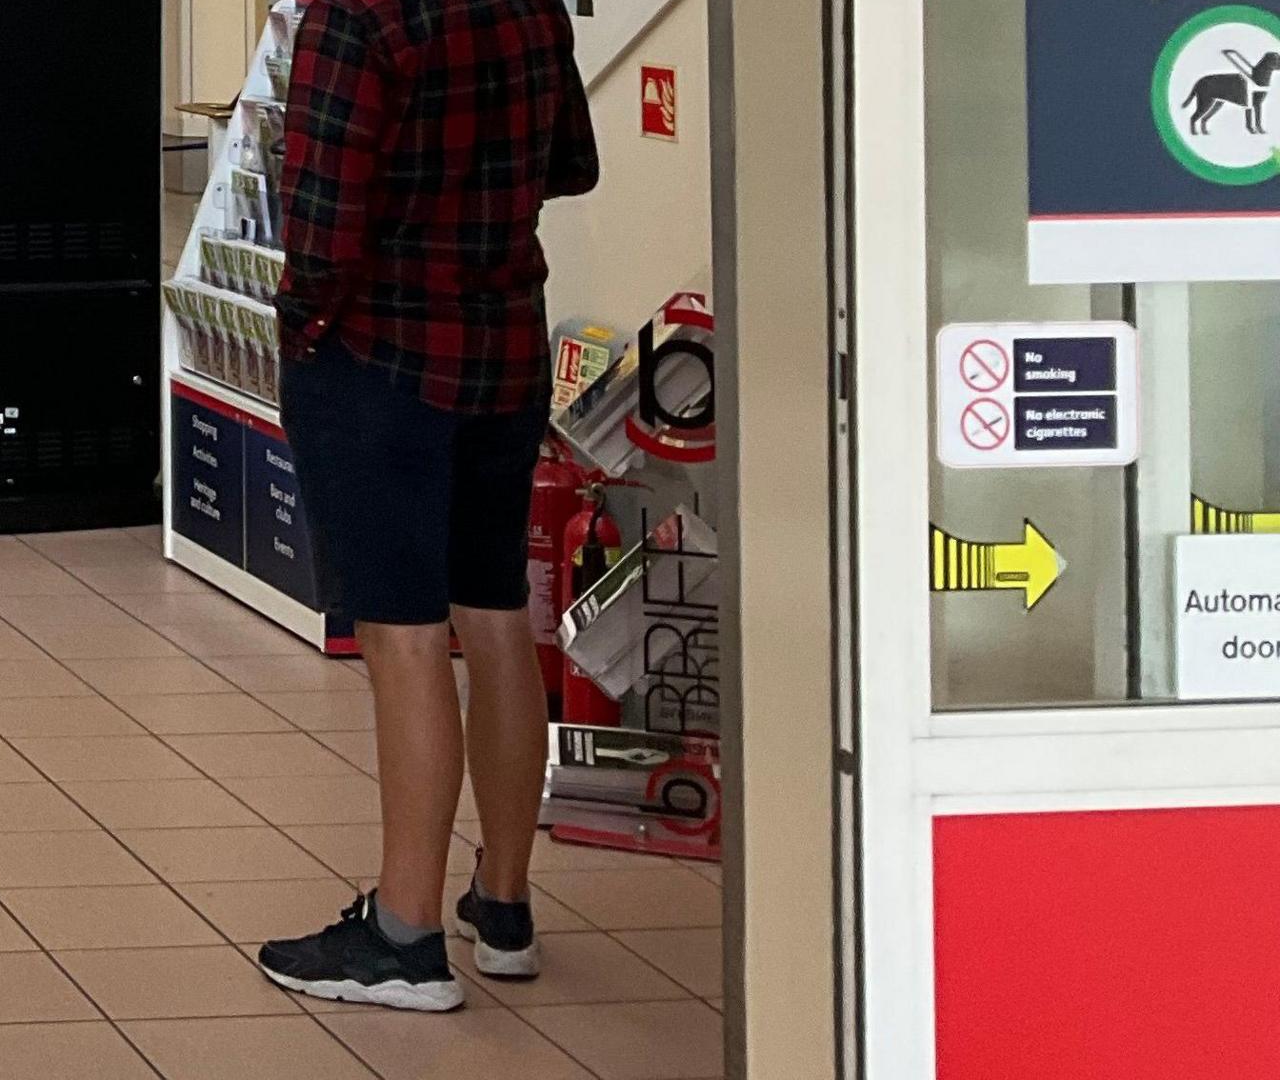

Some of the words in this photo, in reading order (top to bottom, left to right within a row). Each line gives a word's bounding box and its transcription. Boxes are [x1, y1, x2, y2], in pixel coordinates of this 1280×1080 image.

[1025, 351, 1043, 364] No
[1025, 366, 1076, 383] smoking
[1025, 408, 1043, 422] No
[1045, 407, 1106, 422] electronic
[1025, 424, 1087, 440] cigarettes
